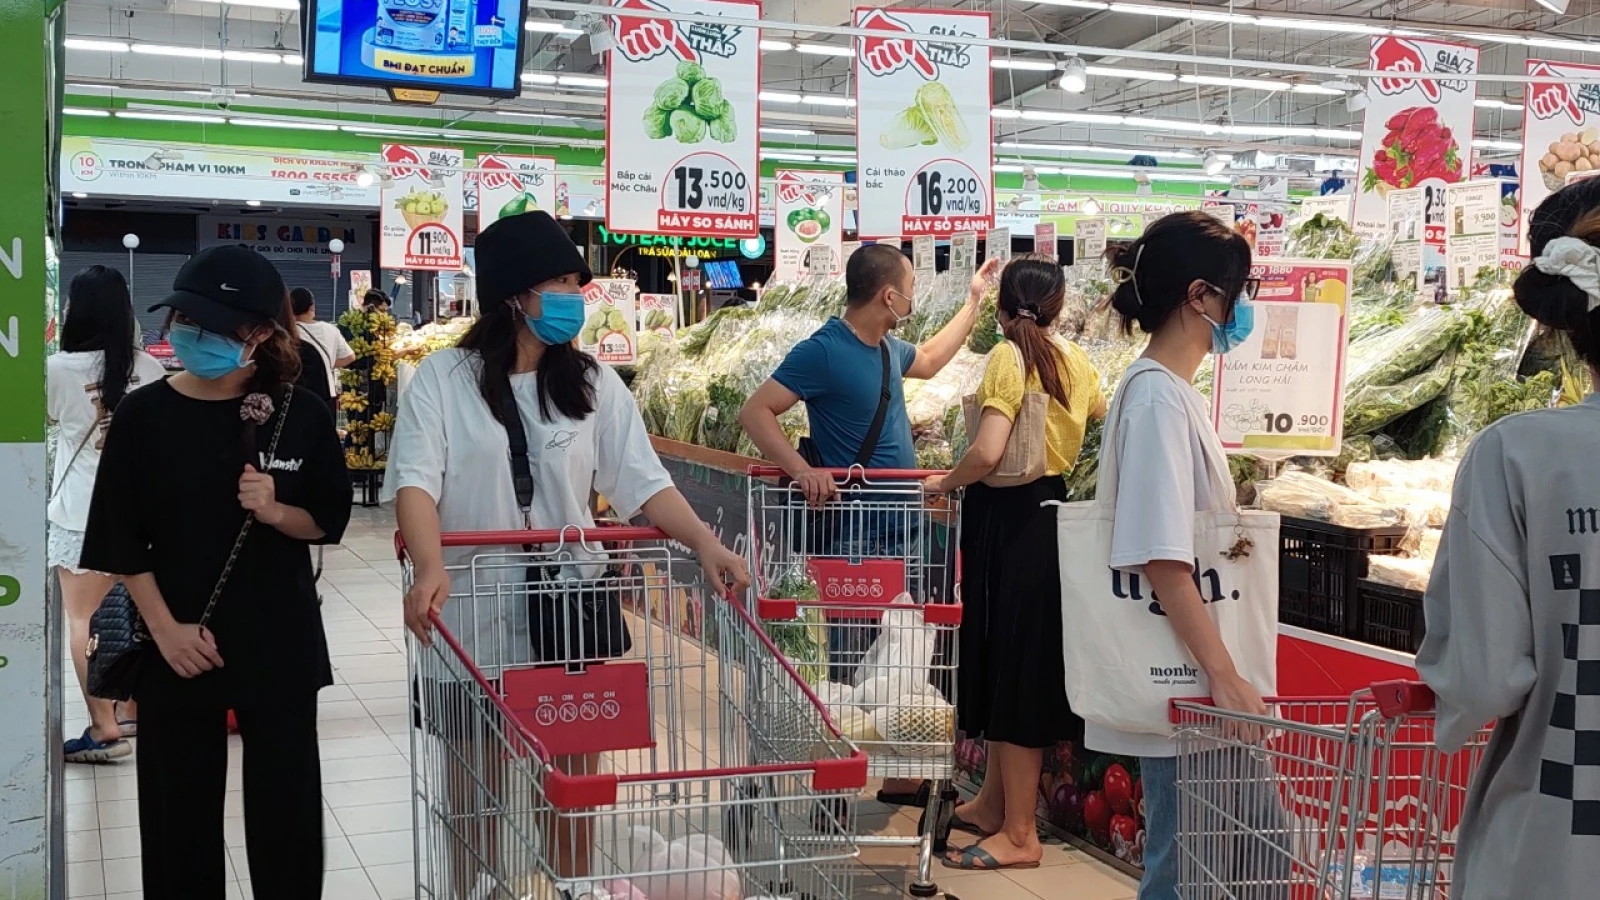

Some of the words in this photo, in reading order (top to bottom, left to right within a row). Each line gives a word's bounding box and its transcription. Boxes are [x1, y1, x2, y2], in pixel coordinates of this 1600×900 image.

[383, 60, 402, 71] BMI
[404, 61, 426, 75] ĐẠT
[428, 60, 466, 75] CHUẨN
[79, 157, 95, 167] 10
[109, 159, 152, 171] TRON
[198, 164, 211, 173] VI
[213, 165, 246, 175] 10KM
[617, 170, 636, 181] Bắp
[611, 182, 631, 191] Mộc
[633, 183, 658, 193] Châu
[659, 213, 691, 227] HÃY
[695, 217, 712, 229] SO
[714, 214, 753, 231] SÁNH
[904, 219, 933, 231] HÃY
[953, 218, 990, 231] SÁNH
[217, 222, 268, 241] KIDS
[277, 224, 356, 245] GARDEN
[1251, 362, 1273, 372] KIM
[1239, 375, 1271, 385] LONG
